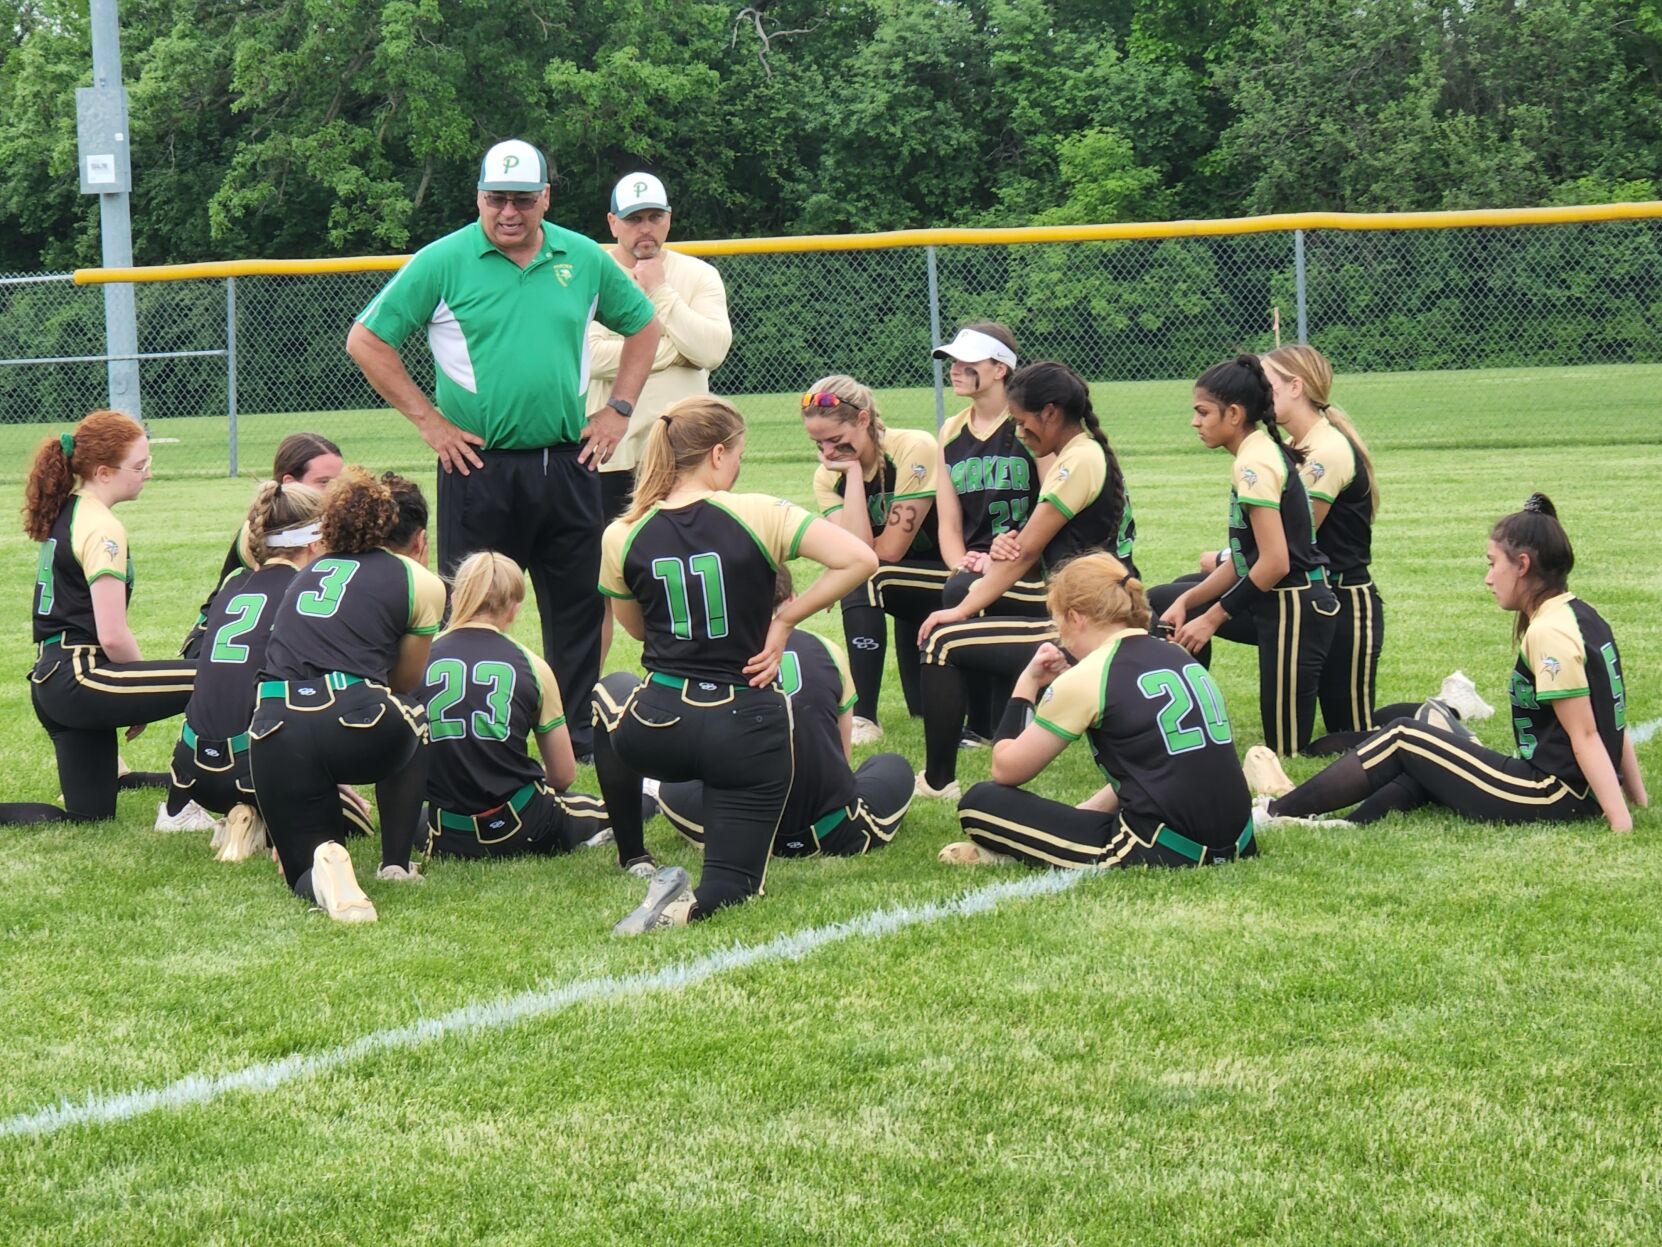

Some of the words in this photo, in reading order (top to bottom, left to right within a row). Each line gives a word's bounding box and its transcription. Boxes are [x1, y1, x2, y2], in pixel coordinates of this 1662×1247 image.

[502, 155, 520, 174] P
[633, 181, 648, 198] P
[944, 455, 1031, 496] ARKER
[889, 503, 917, 533] 53
[296, 558, 361, 618] 3
[651, 551, 730, 641] 11
[210, 592, 268, 664] 2
[425, 657, 517, 742] 23
[1136, 663, 1233, 756] 20
